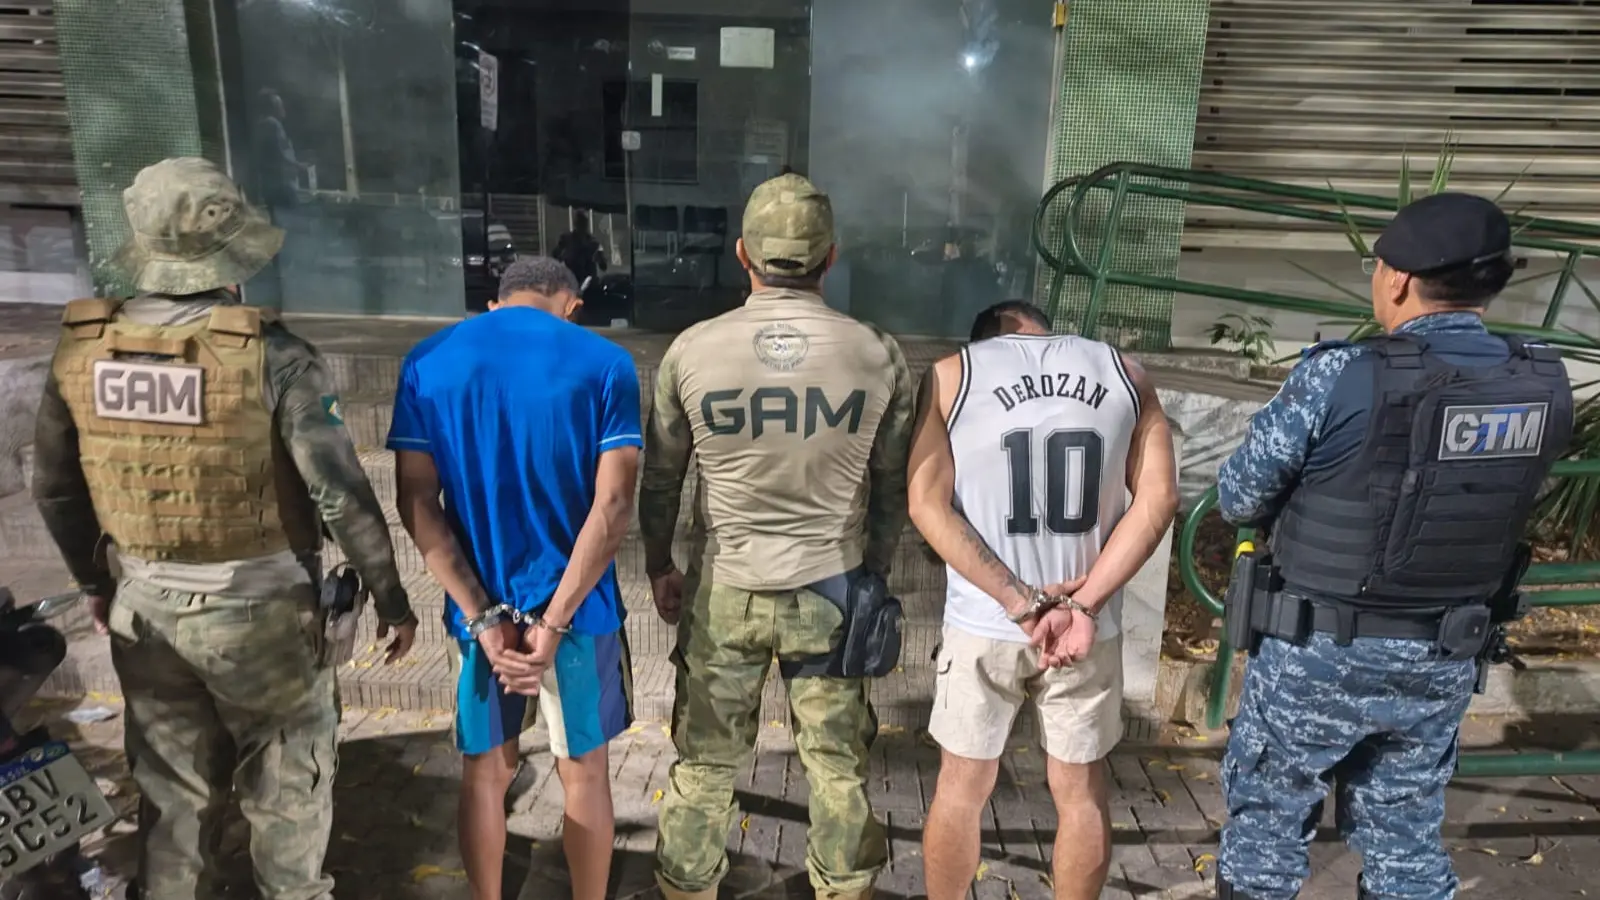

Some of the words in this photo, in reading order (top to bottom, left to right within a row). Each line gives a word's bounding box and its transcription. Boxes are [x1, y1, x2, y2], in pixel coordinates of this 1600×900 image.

[99, 369, 197, 417] GAM
[700, 386, 866, 440] GAM
[1445, 411, 1541, 452] GTM
[1000, 427, 1104, 537] 10
